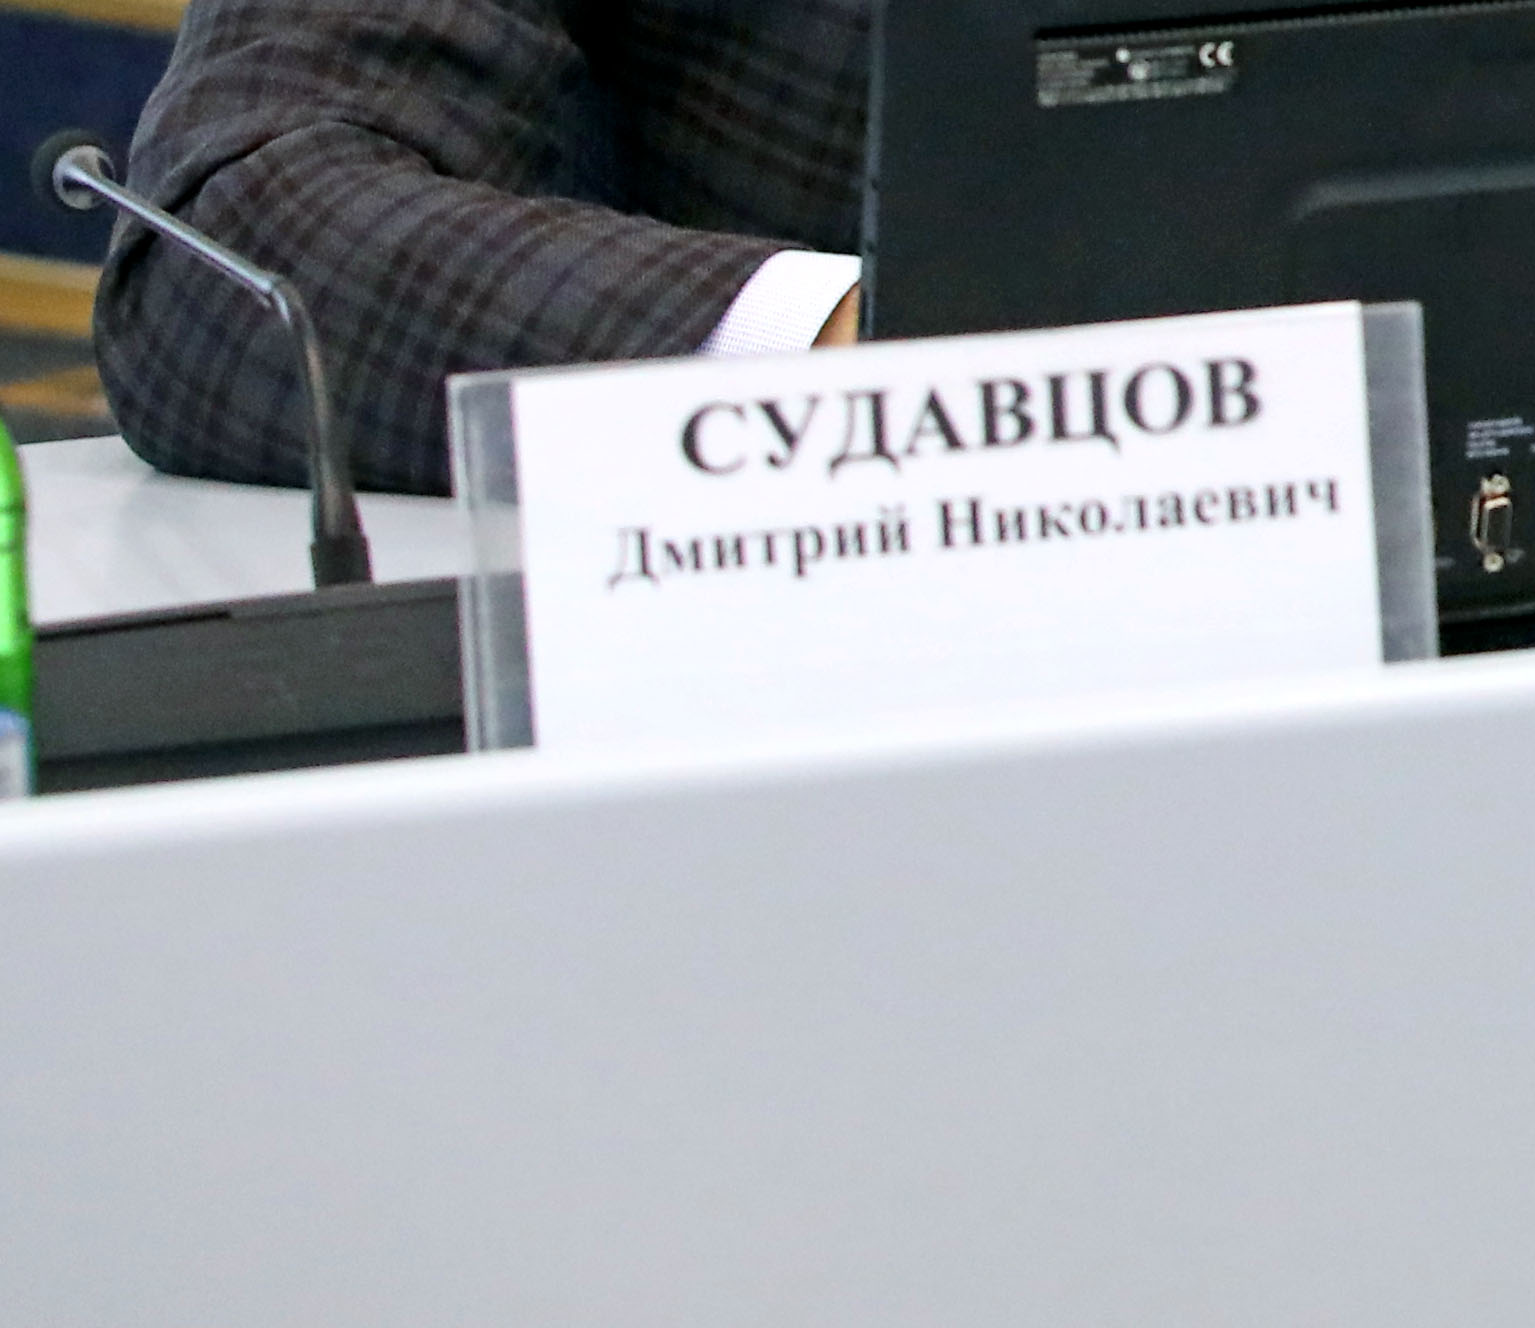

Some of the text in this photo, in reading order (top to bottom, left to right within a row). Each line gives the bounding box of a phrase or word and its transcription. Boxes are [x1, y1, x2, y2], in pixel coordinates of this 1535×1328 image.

[680, 357, 1262, 479] СУДАВЦОВ
[607, 478, 1342, 592] Дмитрий Николаевич
